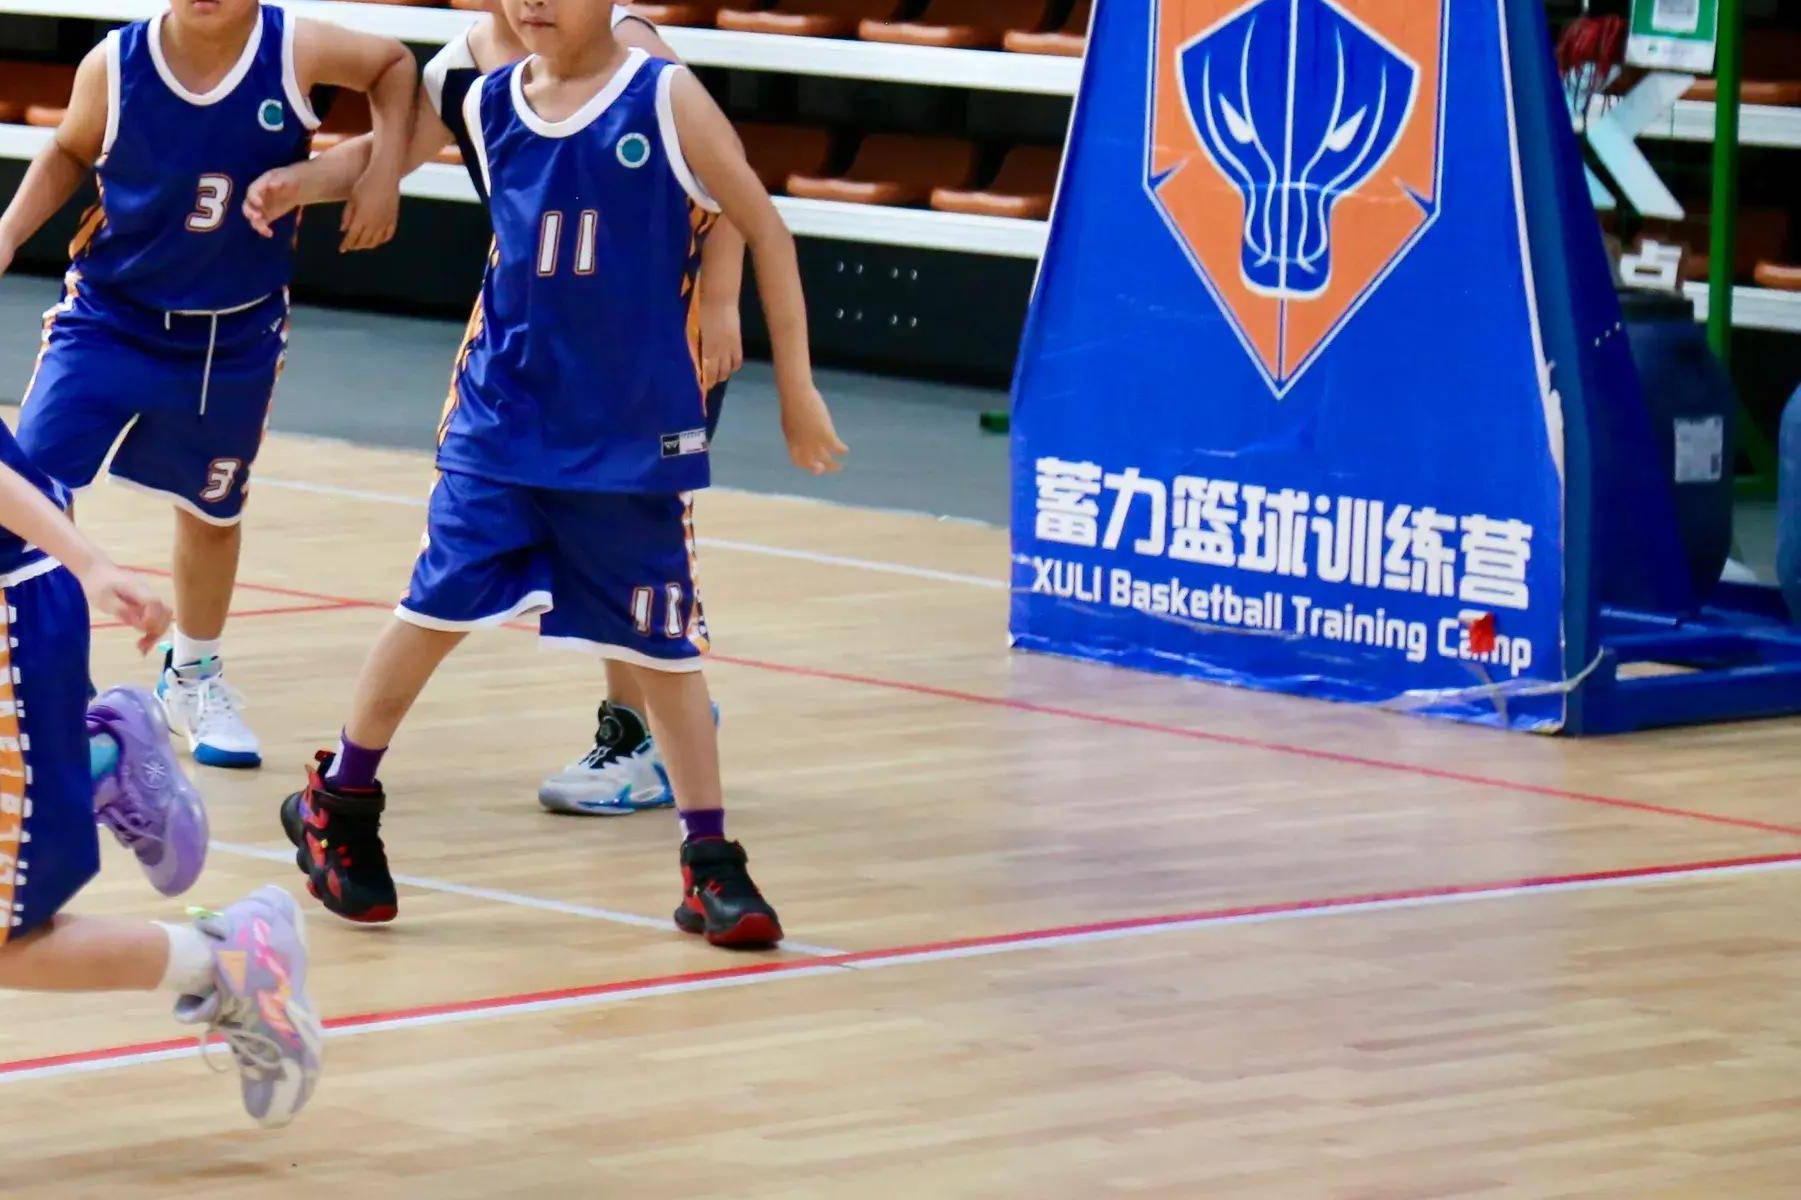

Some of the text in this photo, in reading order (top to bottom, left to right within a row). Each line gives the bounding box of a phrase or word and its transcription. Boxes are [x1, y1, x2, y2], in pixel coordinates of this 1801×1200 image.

[185, 172, 234, 233] 3
[536, 209, 599, 277] 11
[199, 457, 243, 503] 3
[1035, 455, 1533, 611] 蓄力篮球训练营
[631, 582, 684, 638] 11
[1032, 555, 1102, 603] XULI
[1109, 568, 1283, 631] Basketball
[1290, 595, 1428, 663] Training
